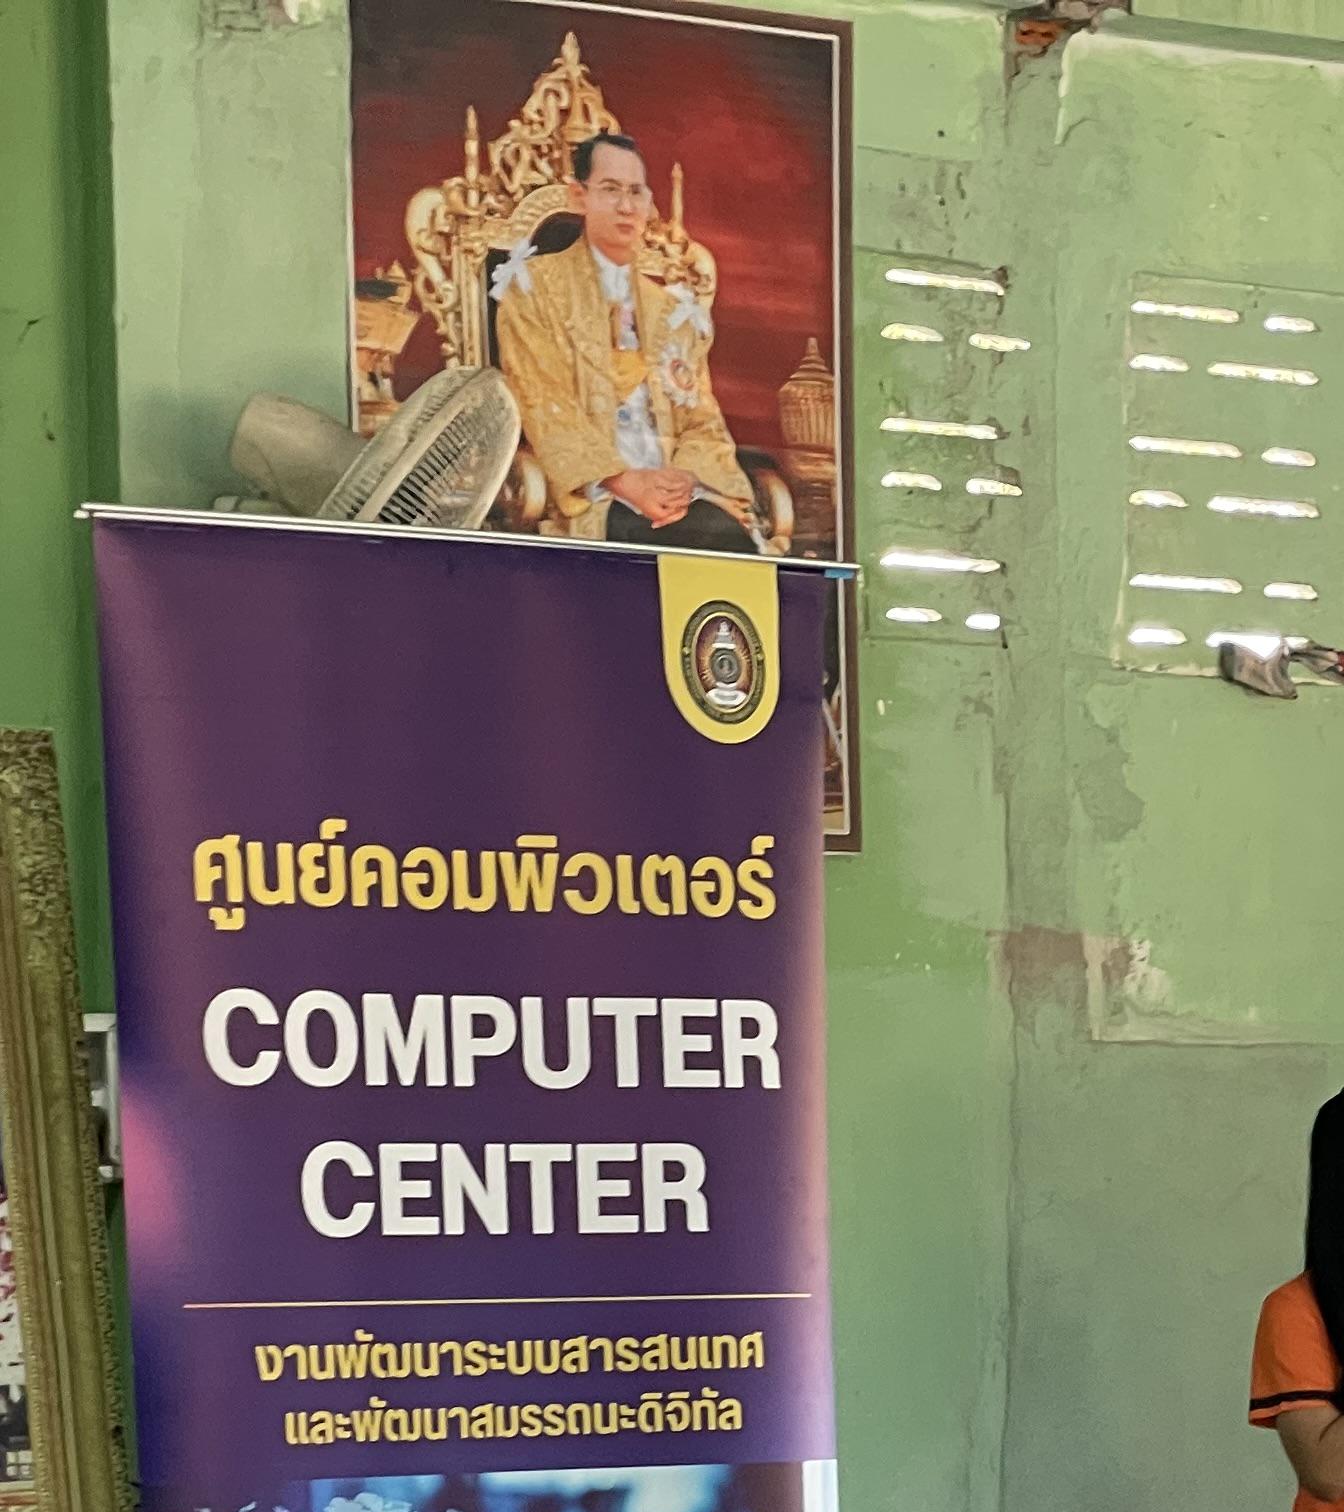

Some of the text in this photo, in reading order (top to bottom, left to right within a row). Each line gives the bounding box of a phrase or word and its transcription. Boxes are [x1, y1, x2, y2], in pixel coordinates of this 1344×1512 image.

[194, 817, 776, 931] ศูนย์คอมพิวเตอร์
[203, 988, 781, 1090] COMPUTER
[301, 1140, 709, 1238] CENTER
[256, 1328, 764, 1379] งานพัฒนาระบบสารสนเทศ
[285, 1395, 742, 1447] และพัฒนาสมรรถนะดิจิทัล
